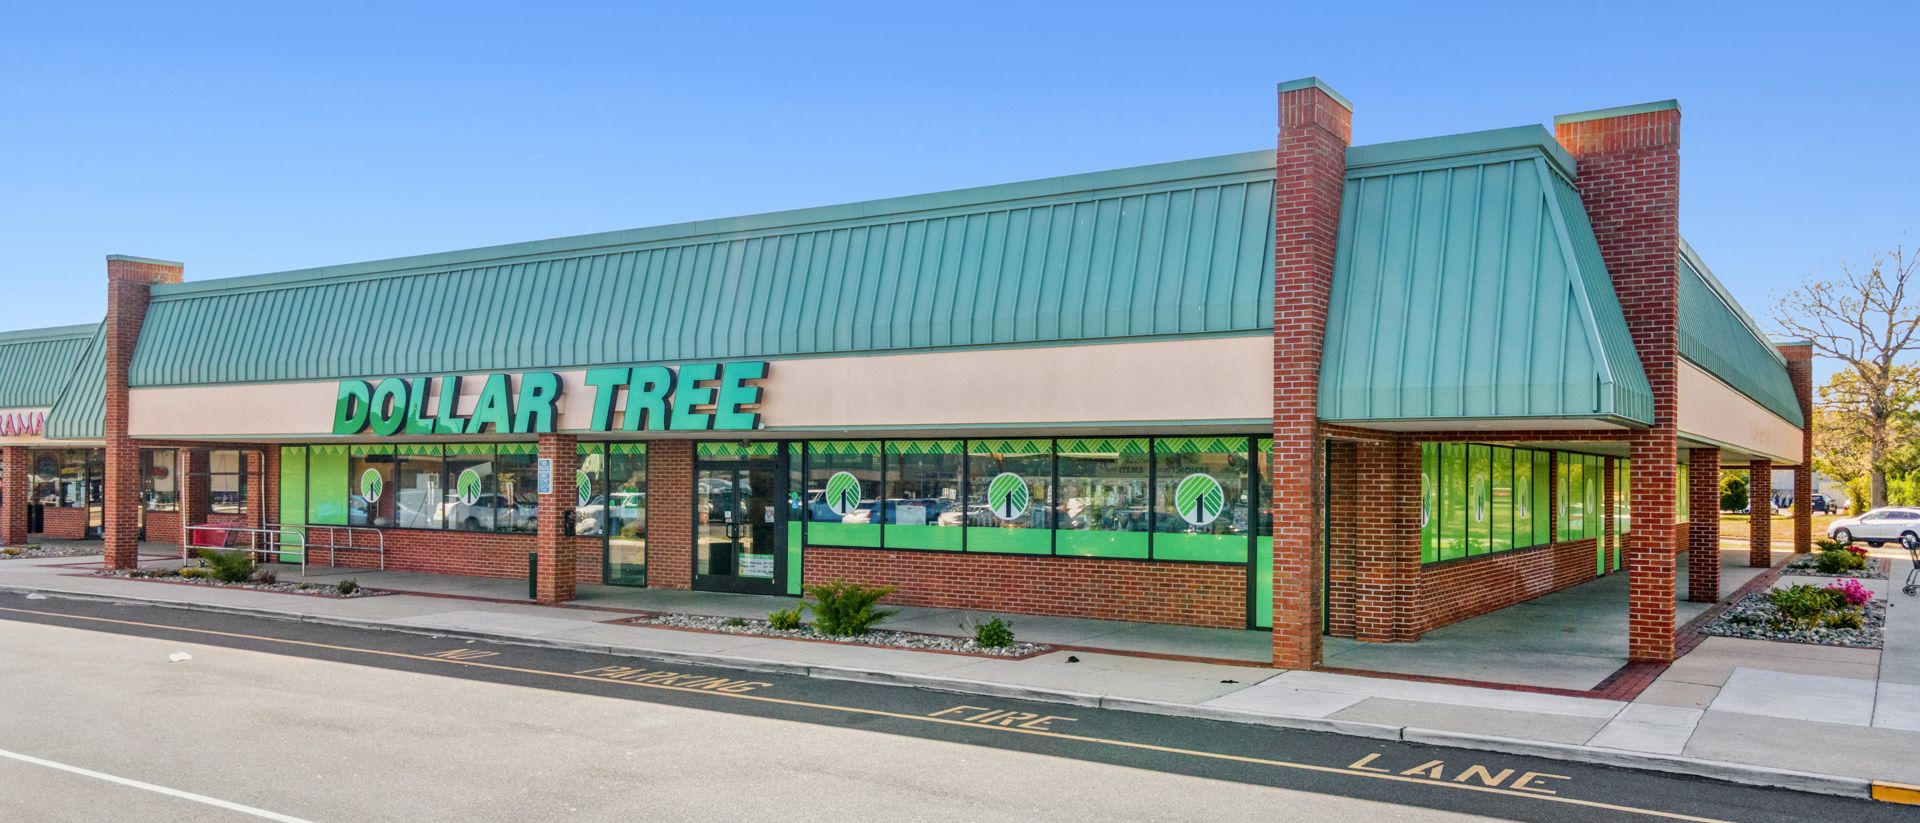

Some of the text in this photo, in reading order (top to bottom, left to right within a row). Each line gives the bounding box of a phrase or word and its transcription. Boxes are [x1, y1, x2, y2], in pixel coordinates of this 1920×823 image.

[332, 361, 770, 436] DOLLAR TREE
[575, 666, 773, 692] PARKING
[928, 705, 1078, 730] FIRE
[1348, 753, 1571, 792] LANE
